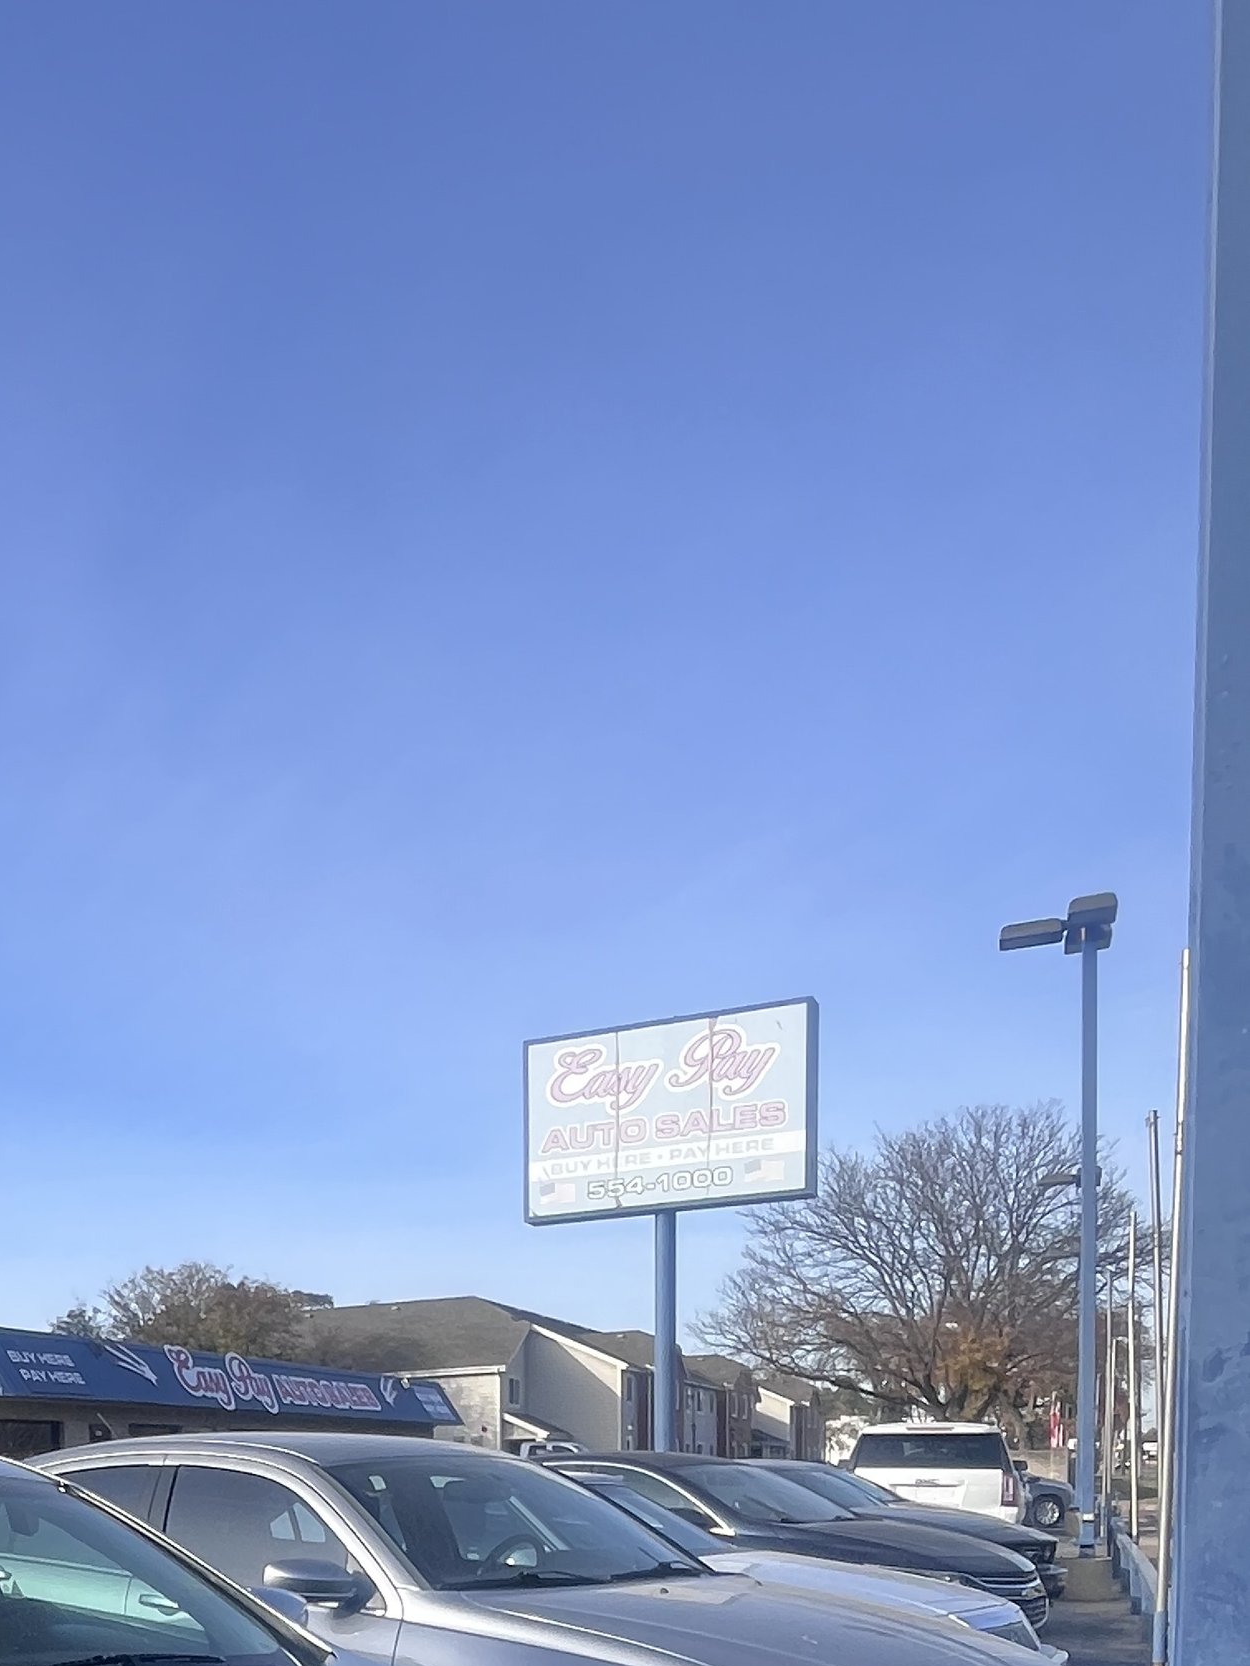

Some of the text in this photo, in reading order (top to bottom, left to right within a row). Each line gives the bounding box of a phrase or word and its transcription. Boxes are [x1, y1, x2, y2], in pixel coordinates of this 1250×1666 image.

[549, 1028, 776, 1111] Easy Pay
[541, 1101, 787, 1154] AUTO SALES
[549, 1160, 594, 1177] BUY
[668, 1144, 710, 1161] PAY
[715, 1137, 775, 1157] HERE
[587, 1166, 734, 1200] 554-1000
[6, 1349, 36, 1363] BUY
[19, 1368, 48, 1382] PAY
